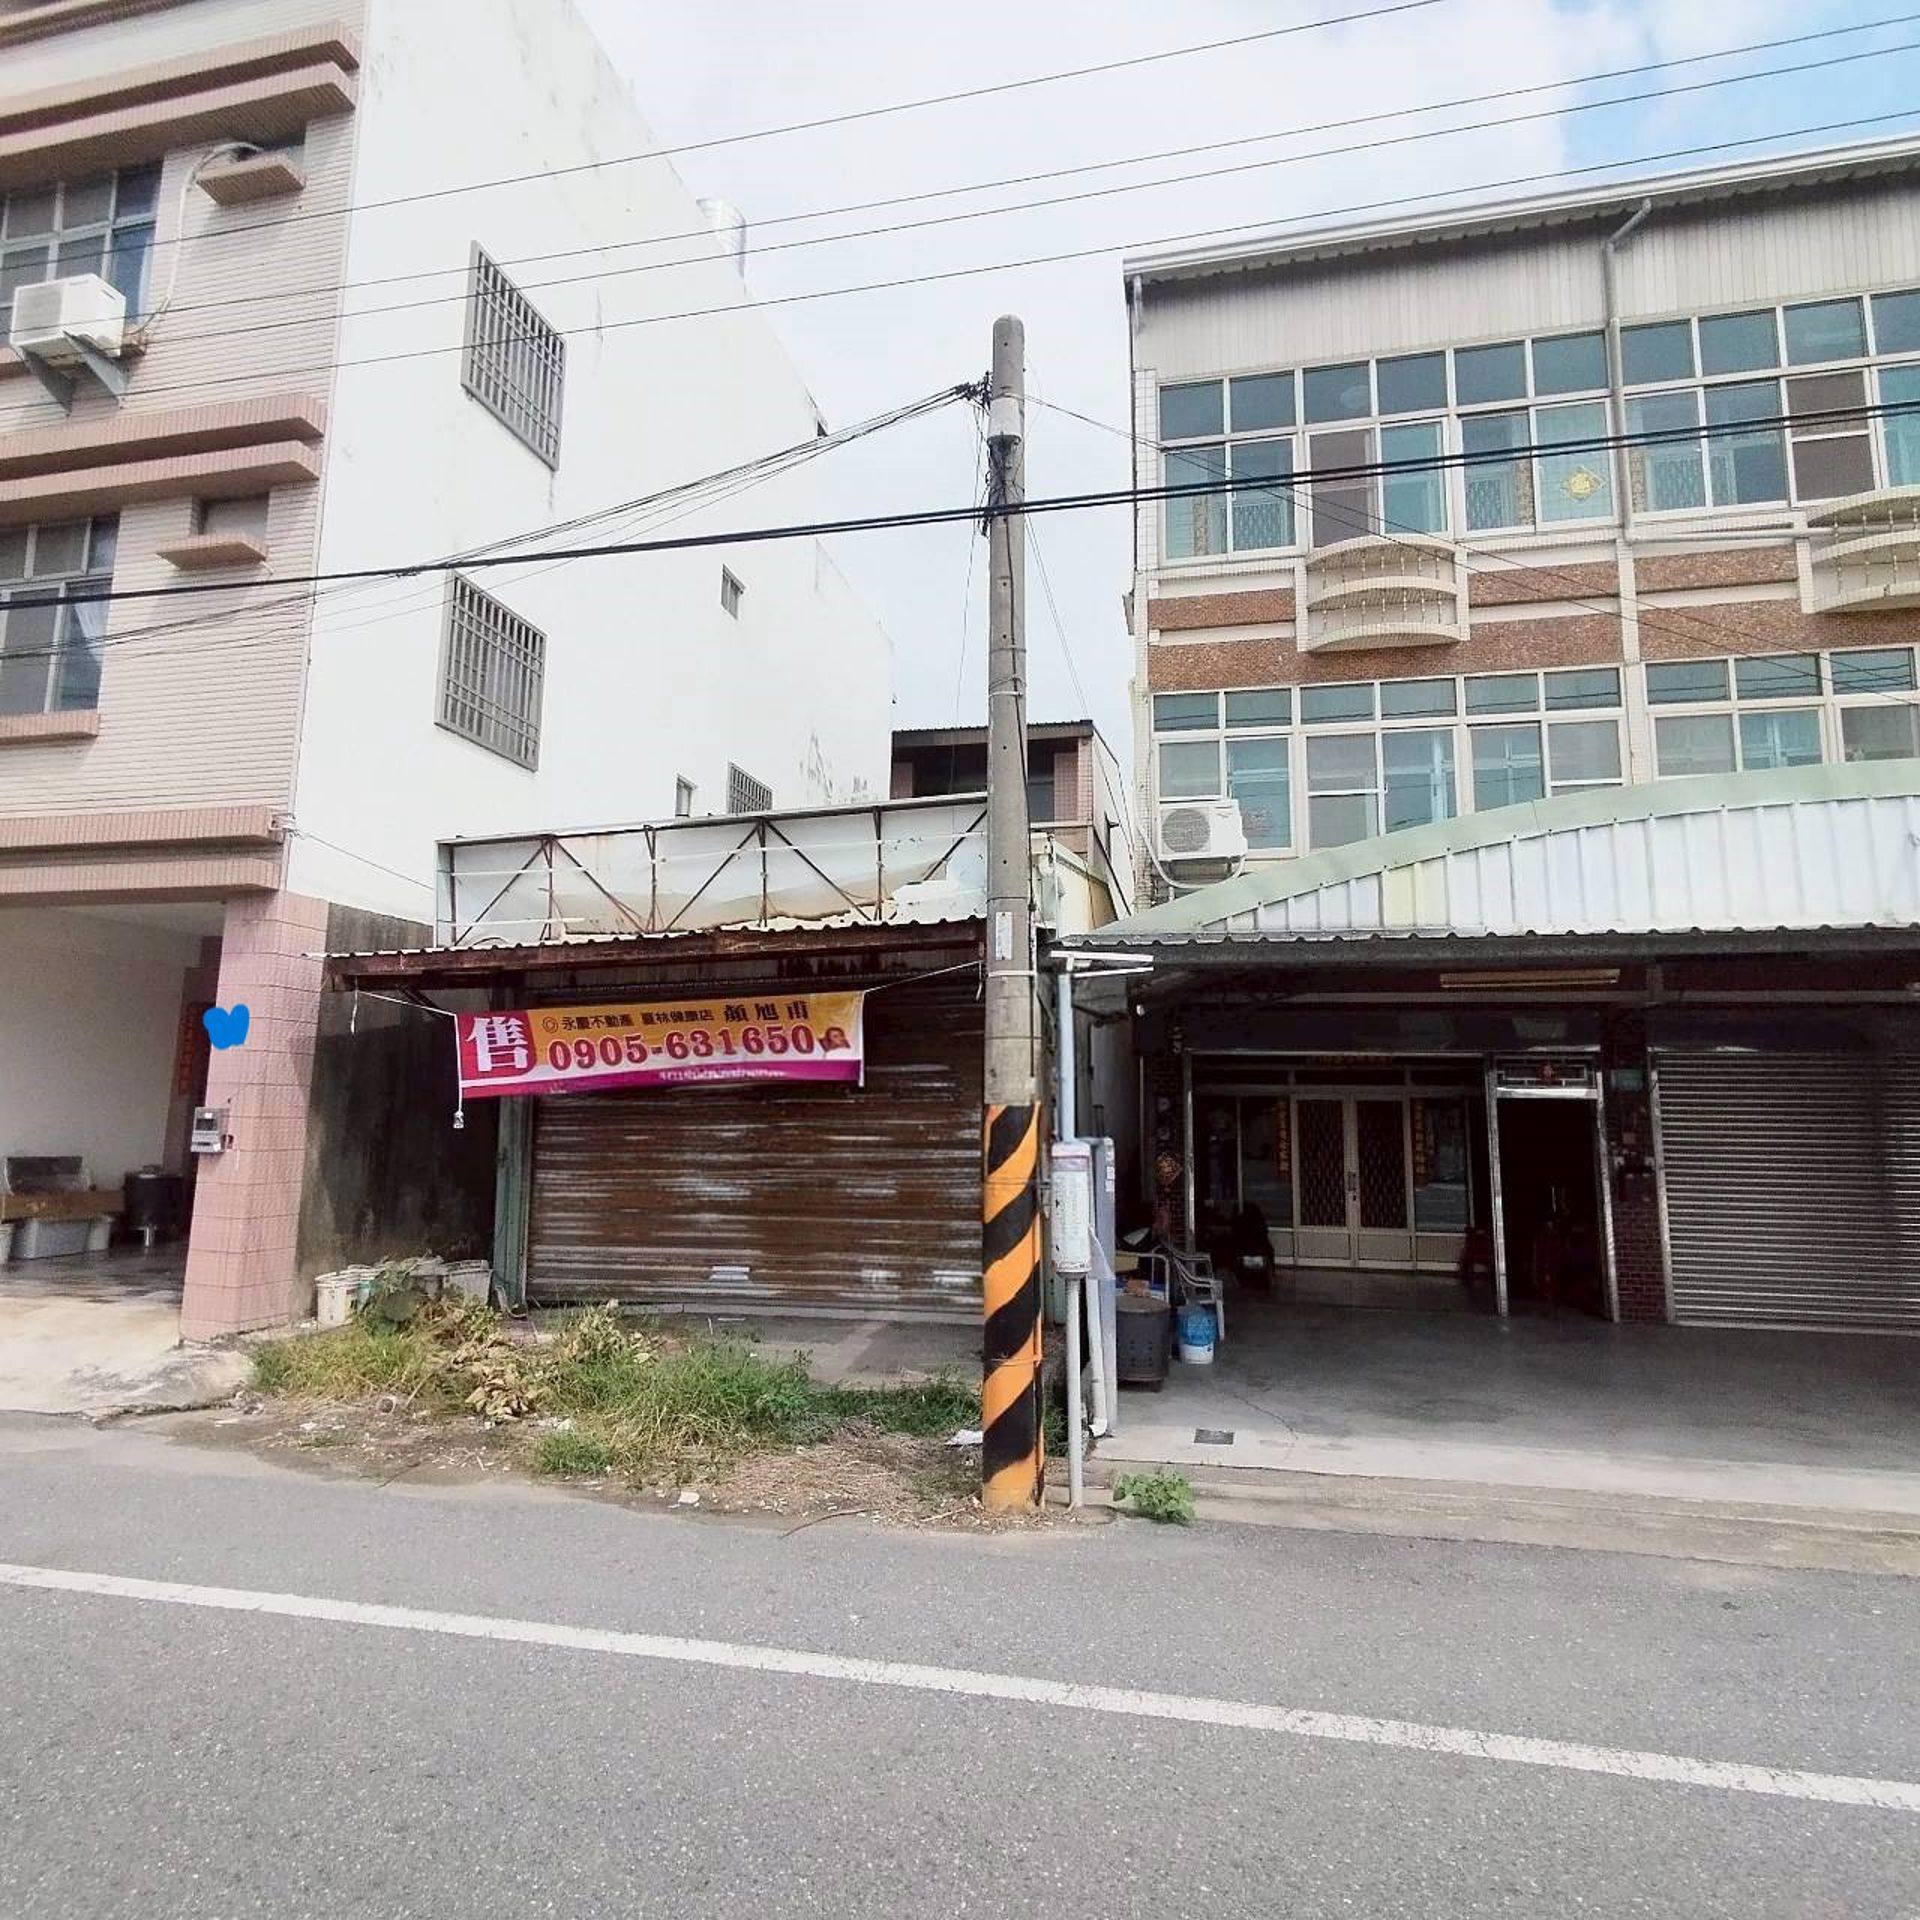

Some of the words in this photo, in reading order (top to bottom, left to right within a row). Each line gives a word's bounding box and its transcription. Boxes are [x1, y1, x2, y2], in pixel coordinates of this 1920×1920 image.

[467, 1016, 530, 1073] 售
[561, 1014, 635, 1031] 永慶不動產
[547, 1024, 816, 1073] 0905-631650
